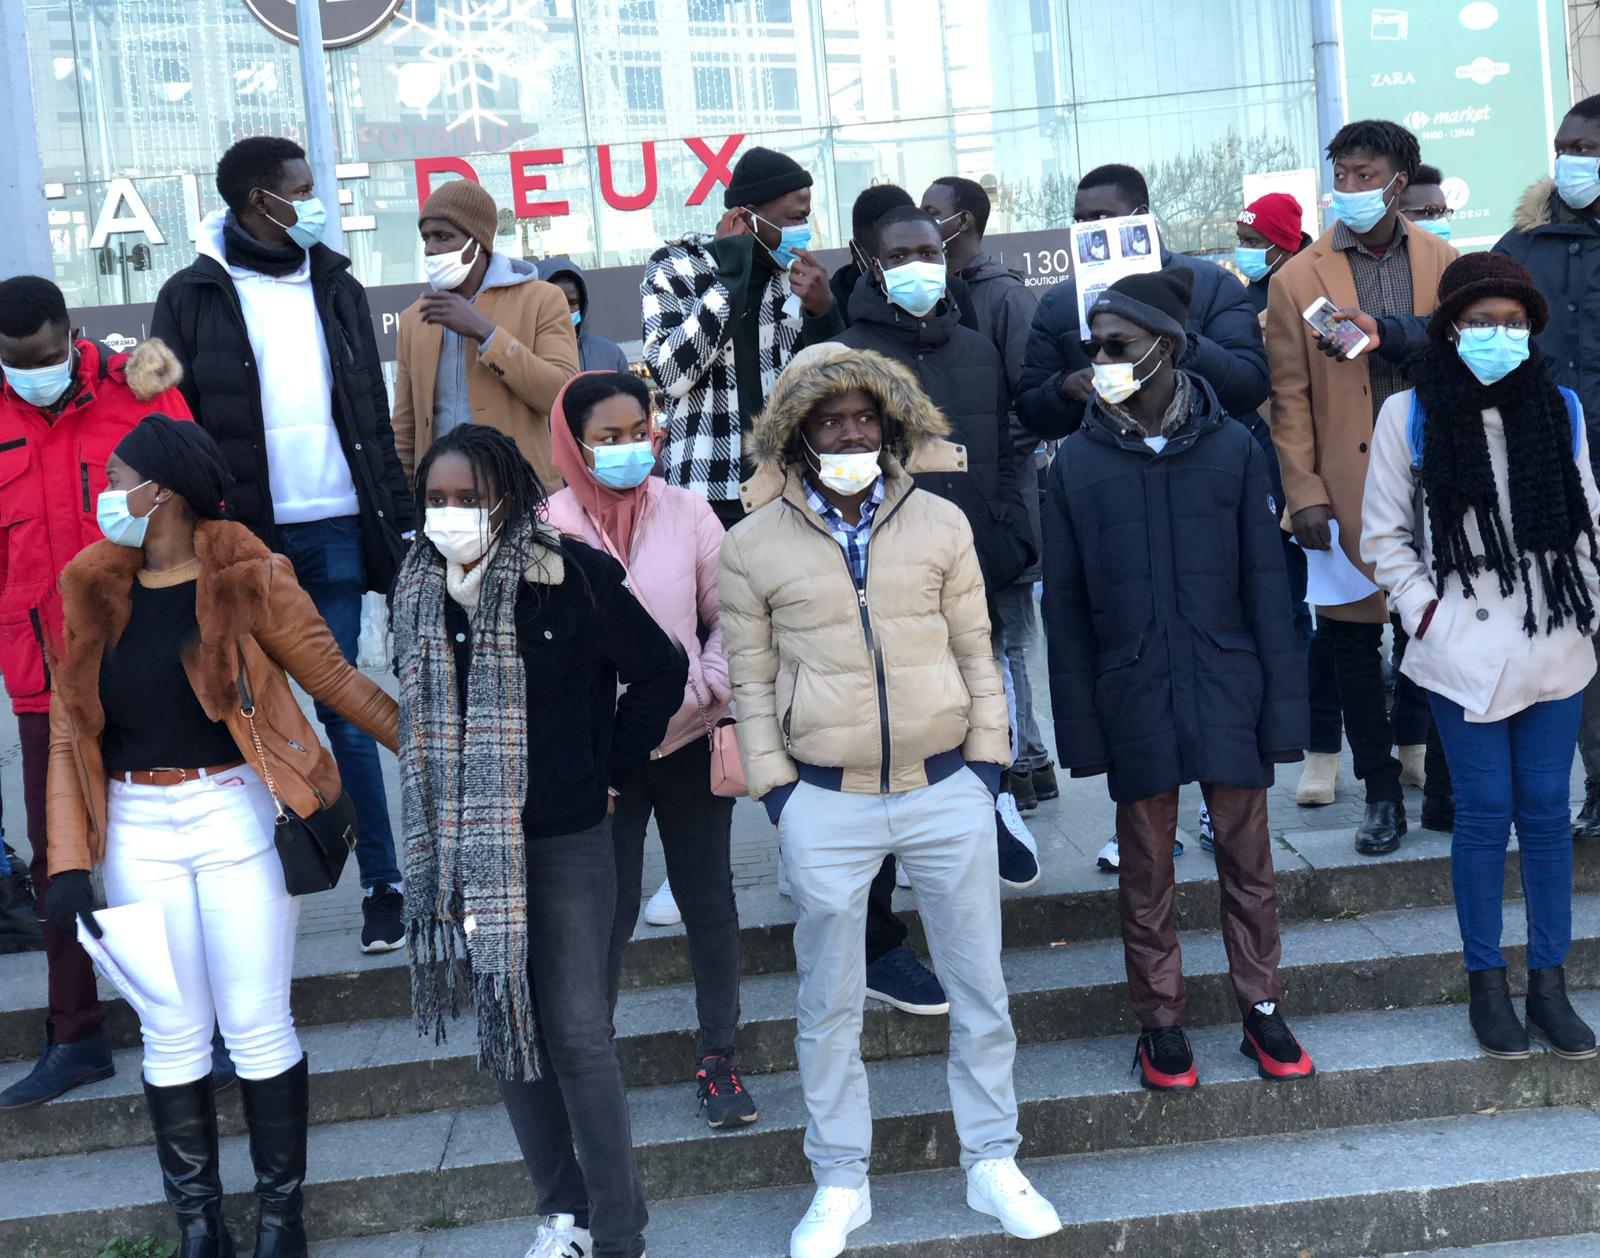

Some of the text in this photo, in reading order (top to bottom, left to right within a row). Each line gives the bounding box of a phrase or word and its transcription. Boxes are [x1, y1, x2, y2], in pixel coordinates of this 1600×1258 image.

[1370, 71, 1416, 87] ZARA
[1433, 104, 1492, 125] market
[414, 134, 746, 218] DEUX
[1023, 249, 1069, 275] 130
